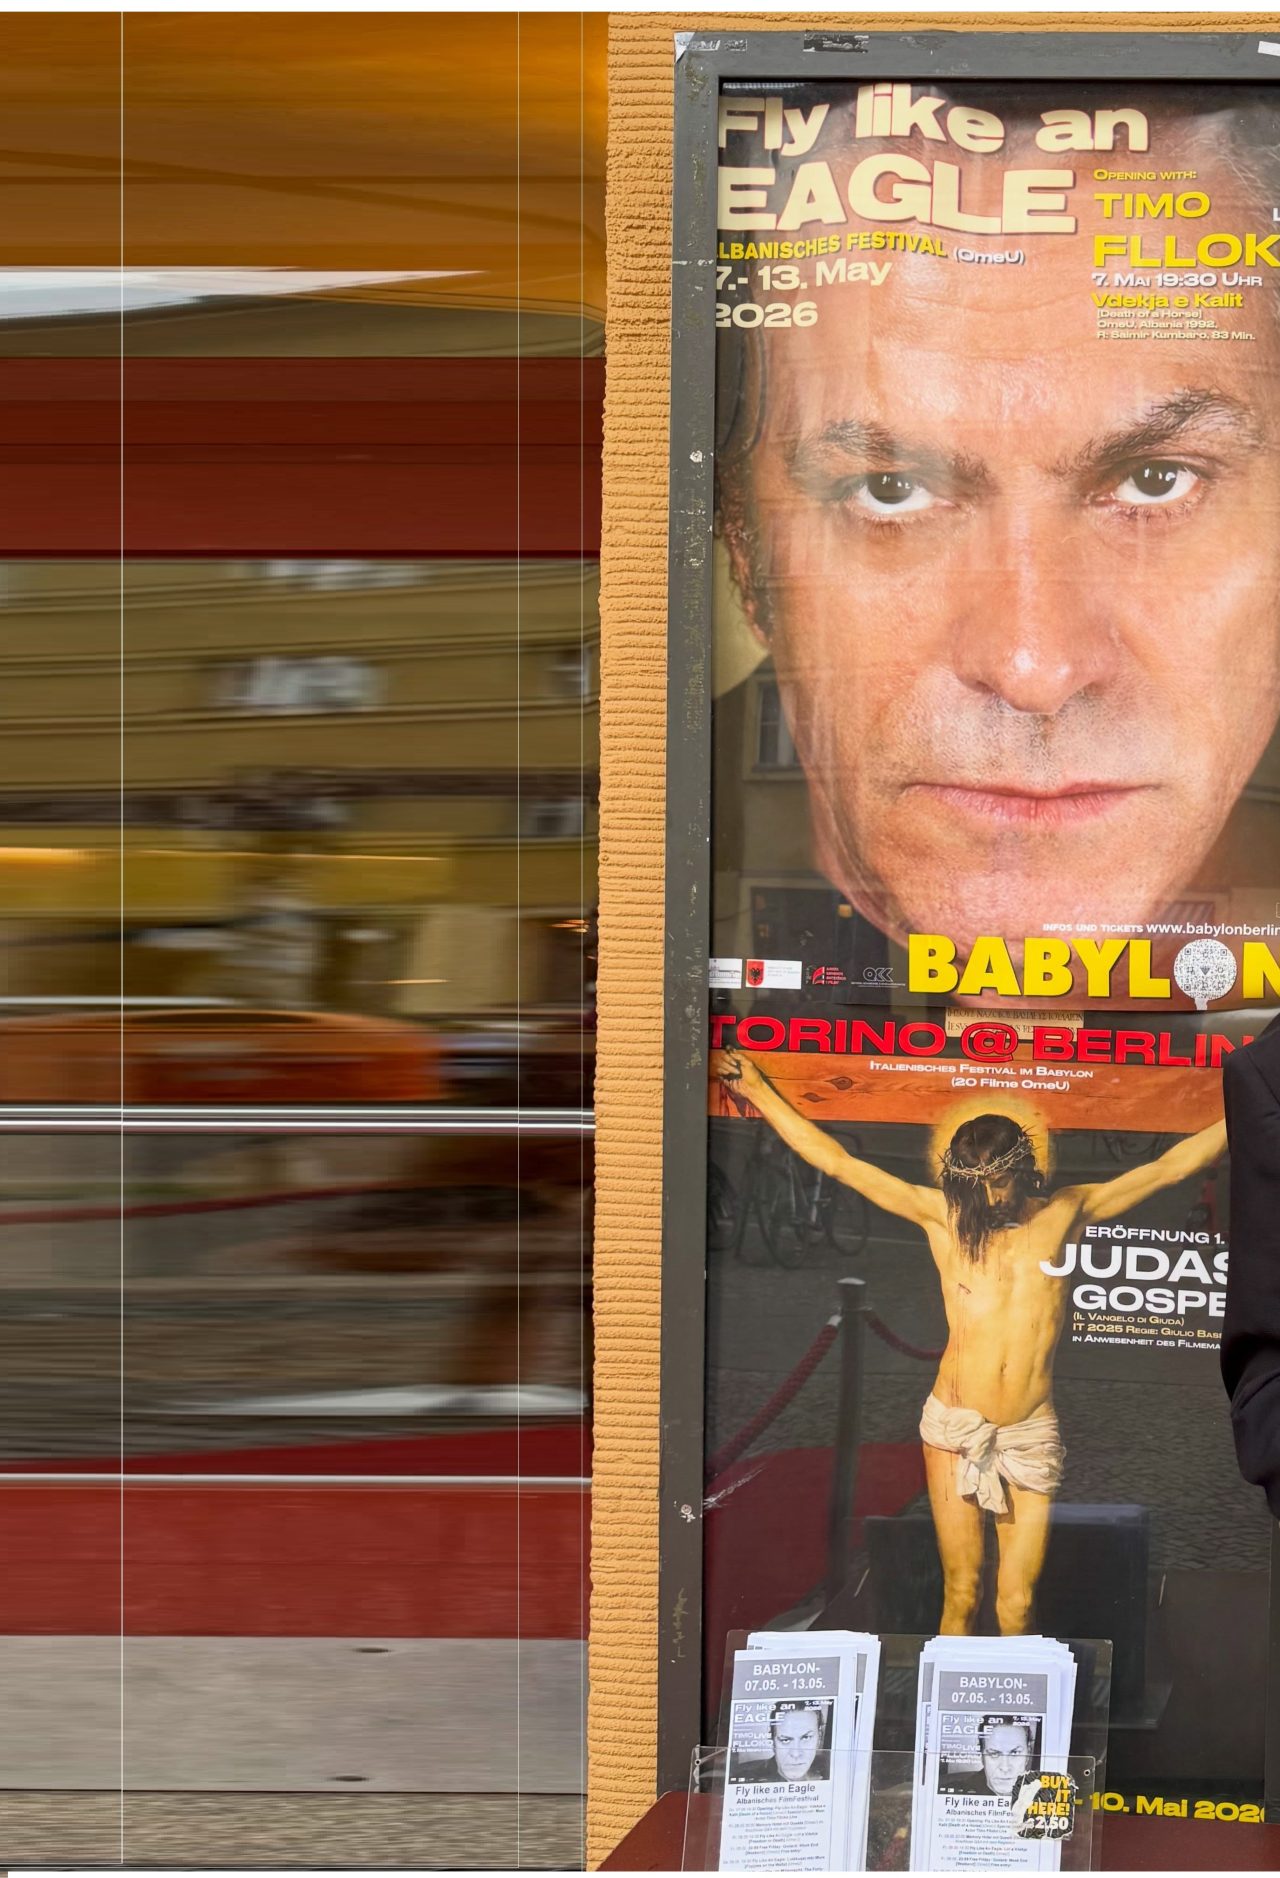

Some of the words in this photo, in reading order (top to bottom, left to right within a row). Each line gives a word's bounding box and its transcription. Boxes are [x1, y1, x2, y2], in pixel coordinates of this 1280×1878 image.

[718, 96, 831, 158] Fly
[855, 83, 1006, 155] like
[1035, 106, 1149, 154] an
[717, 154, 1078, 236] EAGLE
[1094, 191, 1211, 218] TIMO
[716, 234, 840, 260] LBANISCHES
[847, 231, 948, 257] FESTIVAL
[954, 248, 1024, 265] (OmeU)
[758, 265, 808, 290] 13.
[815, 258, 892, 286] May
[1154, 273, 1217, 287] 19:30
[1091, 293, 1169, 310] Vdekja
[1173, 296, 1189, 307] e
[1194, 292, 1244, 308] Kalit
[716, 302, 818, 328] 2026
[1138, 309, 1150, 318] of
[1140, 320, 1183, 328] Albania
[1211, 331, 1229, 339] 83
[1231, 331, 1256, 340] Min.
[710, 1015, 946, 1056] TORINO
[961, 1022, 1018, 1063] @
[951, 1076, 976, 1088] (20
[980, 1078, 1018, 1088] Filme
[1021, 1079, 1070, 1091] OmeU)
[1085, 1225, 1210, 1244] ERÖFFNUNG
[1073, 1322, 1085, 1331] IT
[1087, 1323, 1123, 1333] 2025
[753, 1663, 820, 1676] BABYLON-
[745, 1680, 780, 1691] 07.05.
[792, 1678, 826, 1689] 13.05.
[960, 1676, 1028, 1690] BABYLON-
[951, 1692, 987, 1704] 07.05.
[999, 1693, 1034, 1705] 13.05.
[735, 1704, 753, 1714] Fly
[756, 1703, 777, 1711] like
[734, 1712, 785, 1723] EAGLE
[943, 1715, 959, 1725] Fly
[963, 1715, 984, 1724] like
[942, 1724, 993, 1735] EAGLE
[1041, 1775, 1070, 1788] BUY
[736, 1786, 751, 1797] Fly
[753, 1785, 770, 1794] like
[788, 1784, 816, 1795] Eagle
[736, 1797, 777, 1805] Albanisches
[945, 1797, 959, 1807] Fly
[963, 1797, 980, 1807] like
[982, 1799, 995, 1807] an
[1089, 1791, 1130, 1812] 10.
[1136, 1795, 1188, 1818] Mai
[1194, 1800, 1264, 1824] 202
[946, 1809, 986, 1817] Albanisches
[1028, 1802, 1070, 1816] HERE!
